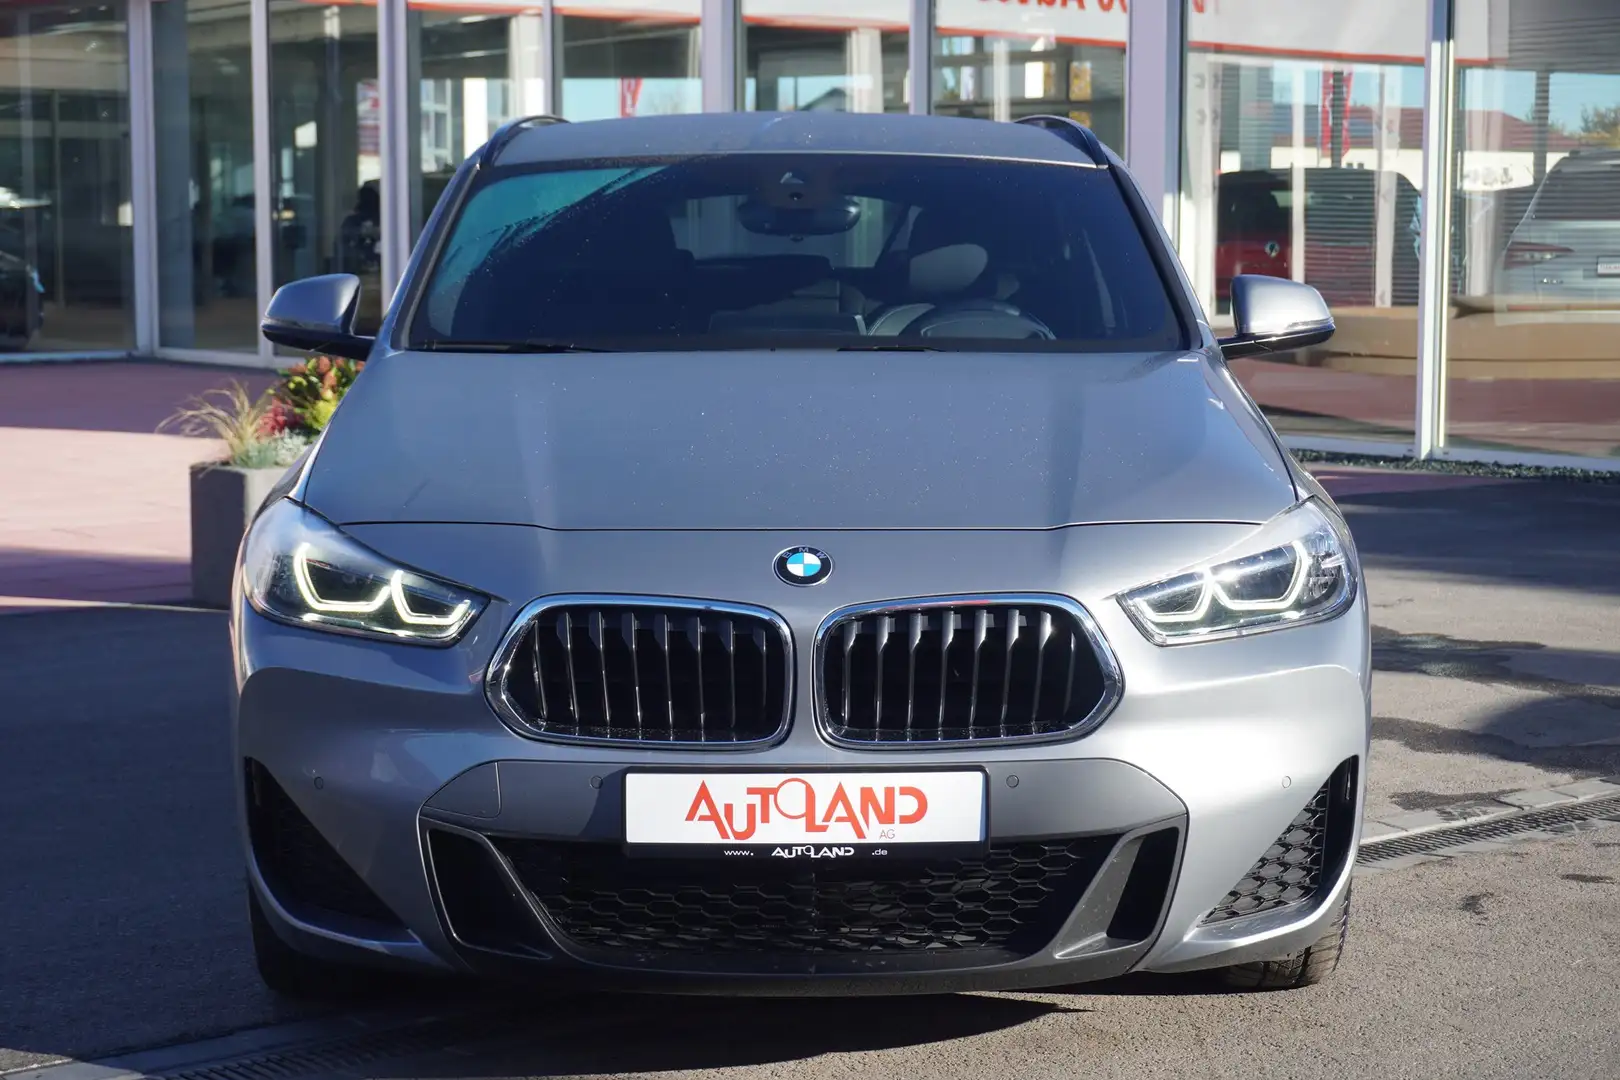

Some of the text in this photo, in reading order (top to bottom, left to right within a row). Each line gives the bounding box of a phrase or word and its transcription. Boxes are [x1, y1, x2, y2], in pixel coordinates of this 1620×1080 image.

[781, 547, 827, 559] BMW
[879, 828, 896, 840] AG
[771, 845, 855, 858] AUTOLAND
